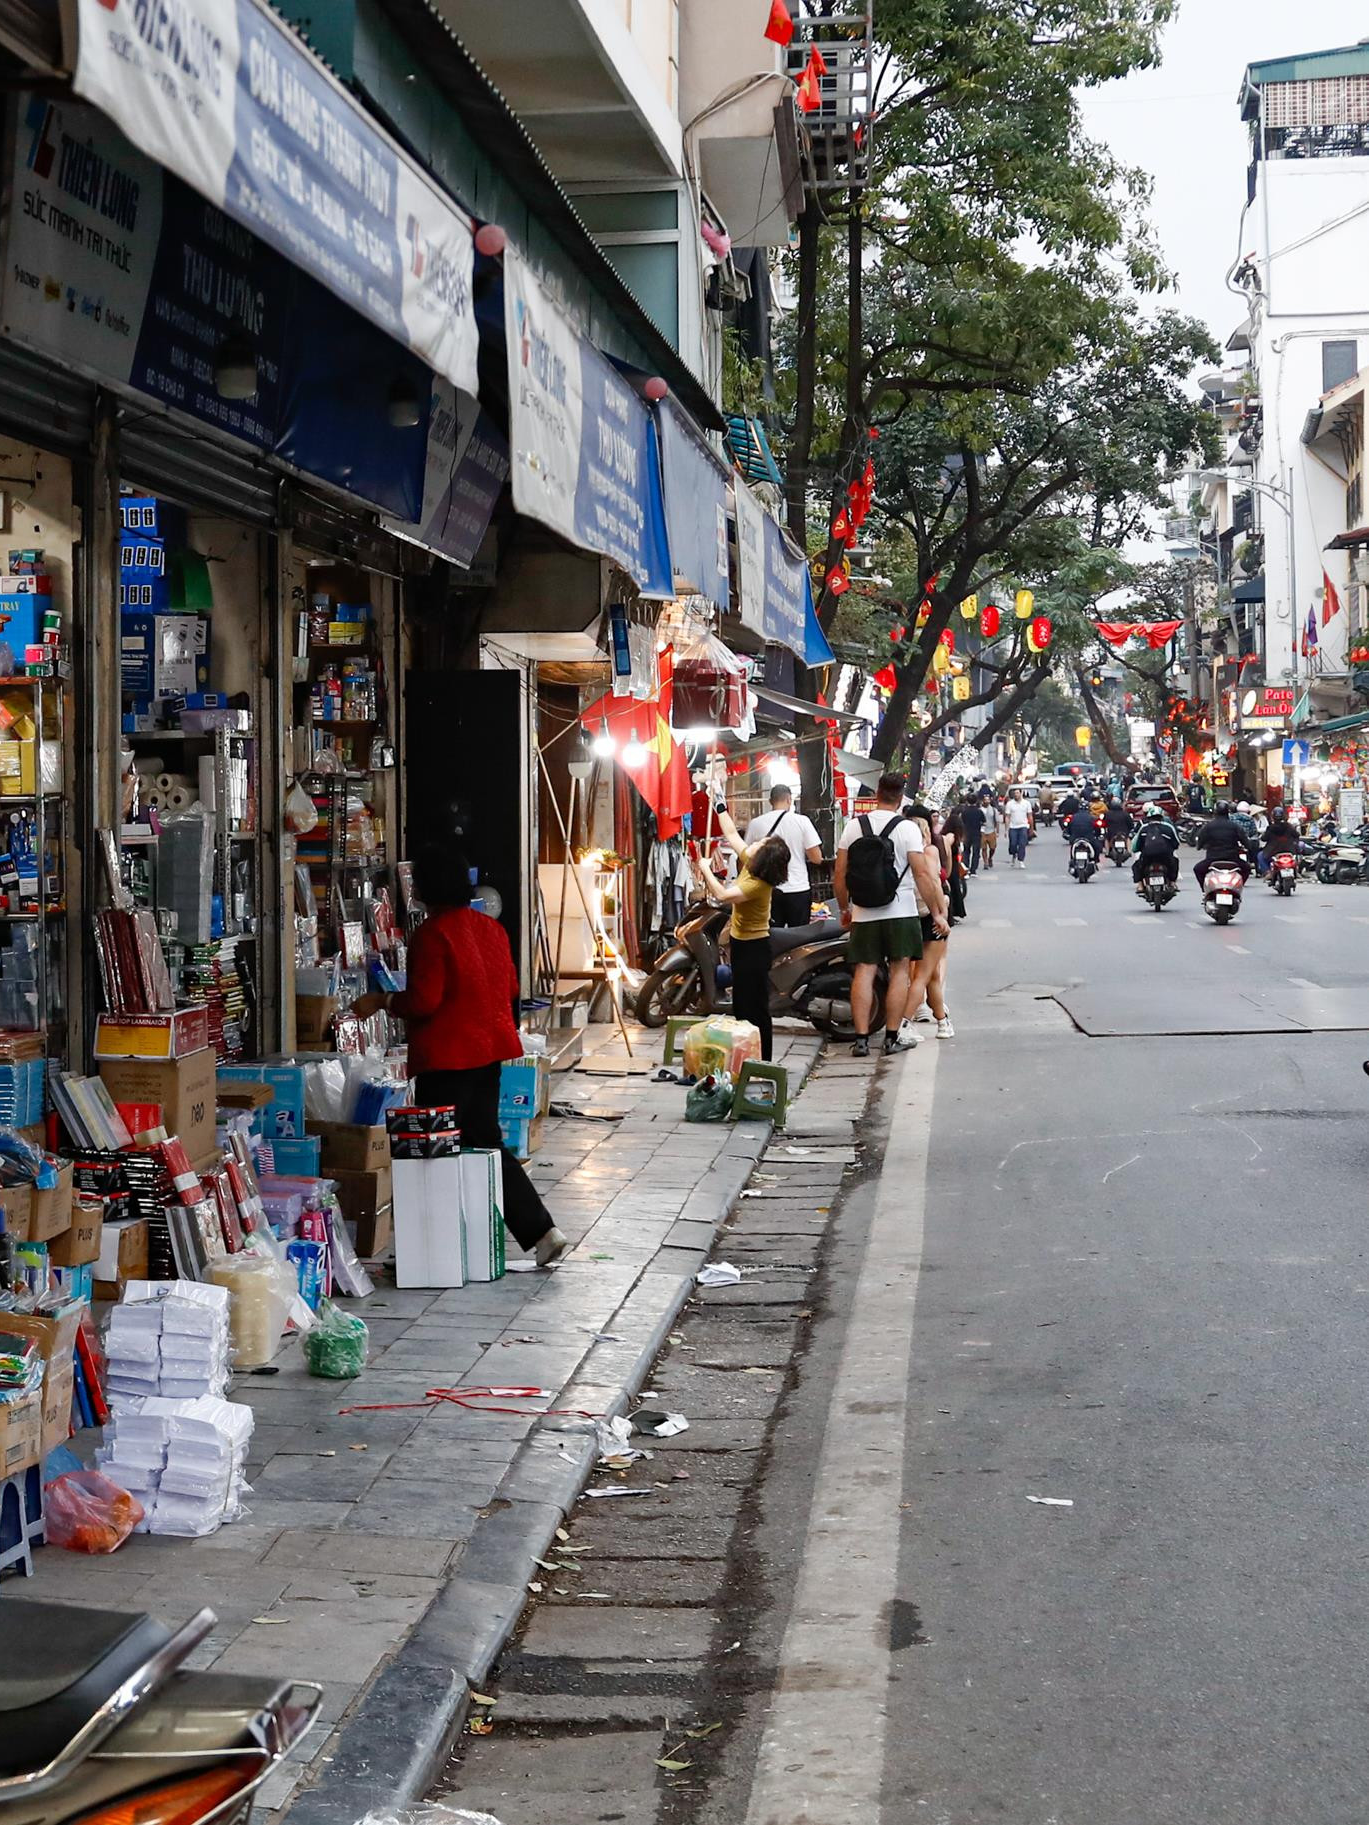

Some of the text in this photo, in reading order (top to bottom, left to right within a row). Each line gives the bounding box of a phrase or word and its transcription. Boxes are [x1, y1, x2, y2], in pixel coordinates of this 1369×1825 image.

[99, 162, 140, 234] LONG
[84, 227, 106, 258] TRI
[0, 601, 21, 612] TRAY
[1264, 688, 1294, 701] Pate
[131, 1018, 168, 1026] LAMINATOR
[77, 1228, 94, 1241] PLUS
